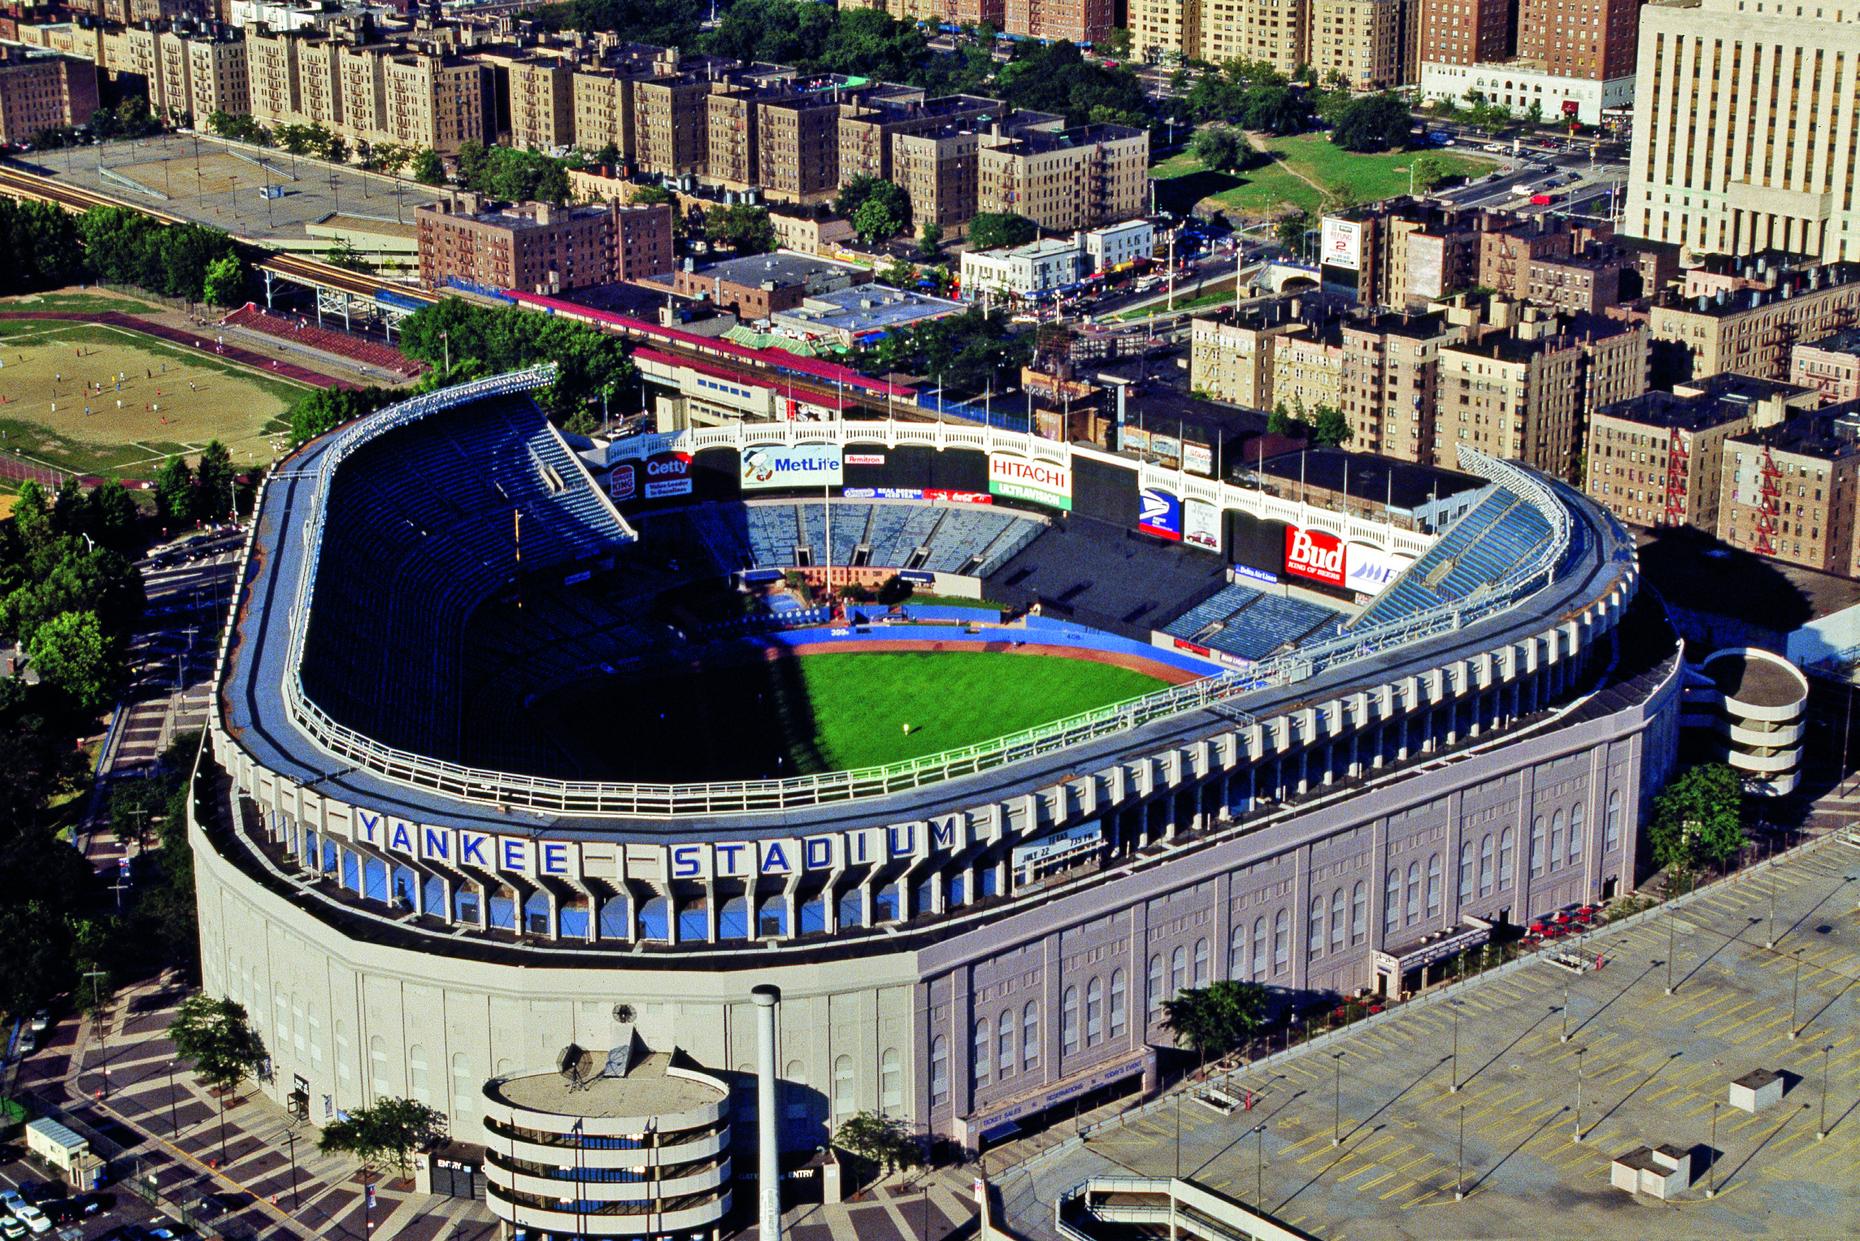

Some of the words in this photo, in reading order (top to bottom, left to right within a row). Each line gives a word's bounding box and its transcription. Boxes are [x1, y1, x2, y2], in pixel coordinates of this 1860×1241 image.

[647, 460, 688, 475] Getty
[775, 458, 840, 471] MetLife
[994, 460, 1064, 487] HITACHI
[613, 478, 633, 490] KING
[999, 483, 1060, 506] ULTRAVISION
[1288, 531, 1346, 573] Bud
[1288, 562, 1306, 572] KING
[1306, 566, 1317, 574] OF
[1316, 569, 1341, 581] BEERS
[359, 811, 569, 874] YANKEE
[674, 817, 956, 877] STADIUM
[1022, 851, 1038, 863] JULY
[1041, 847, 1050, 857] 22
[1125, 1060, 1142, 1072] EVENT
[1004, 1106, 1022, 1118] SALES
[437, 1159, 462, 1170] ENTRY
[788, 1169, 814, 1178] ENTRY
